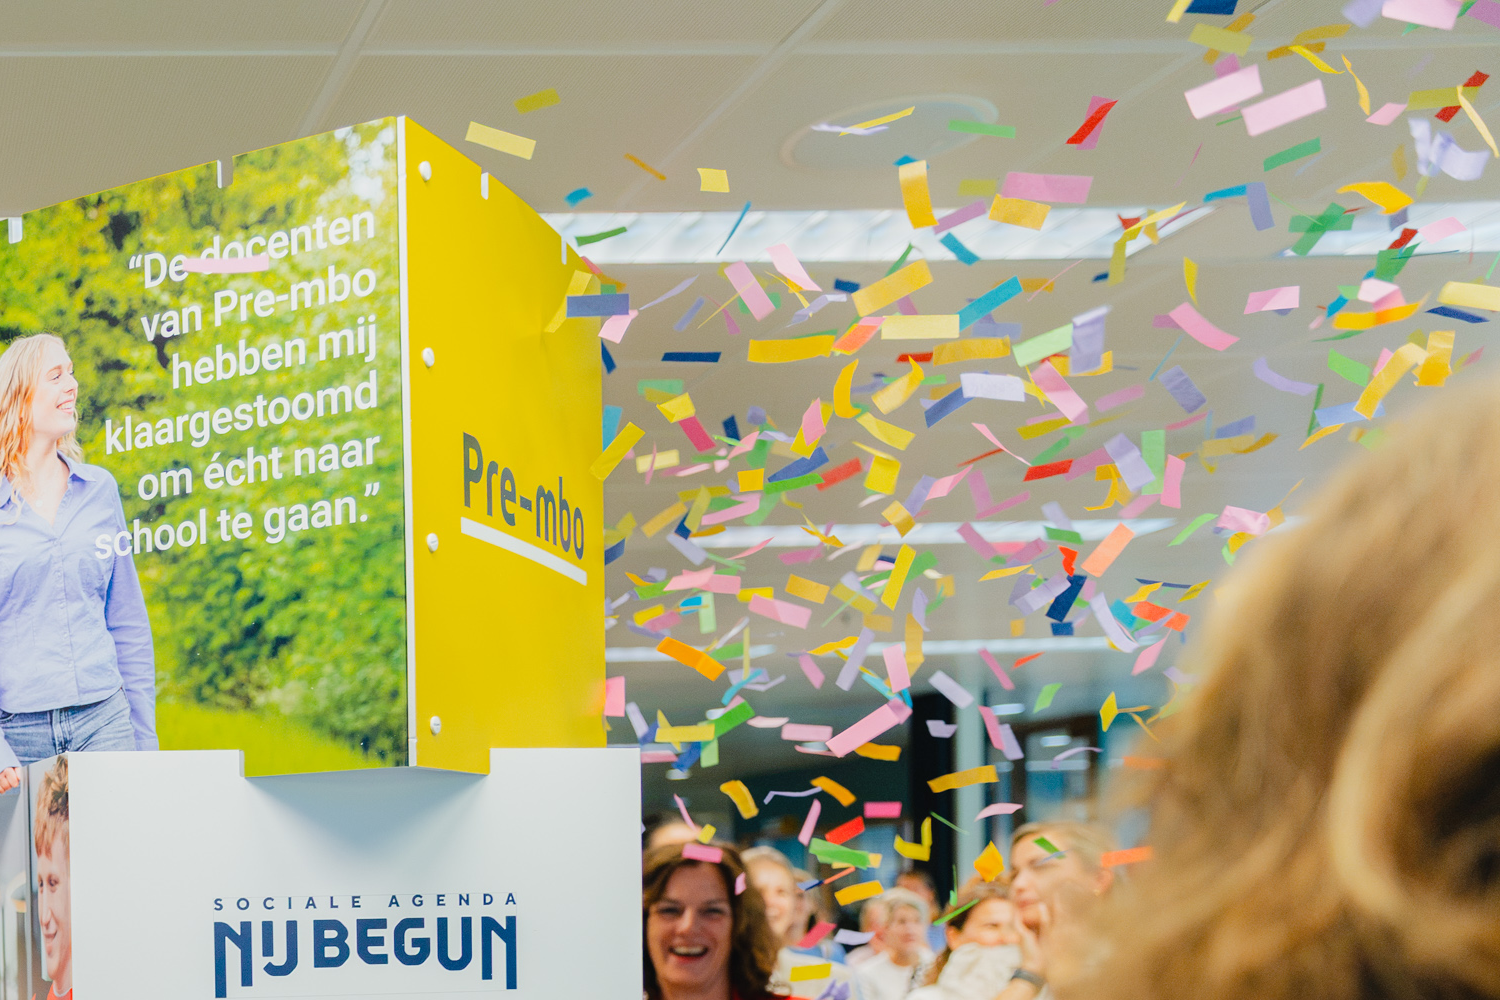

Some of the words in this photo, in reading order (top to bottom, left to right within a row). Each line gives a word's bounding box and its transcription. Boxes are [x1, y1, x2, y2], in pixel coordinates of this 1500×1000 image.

[128, 251, 188, 289] “De
[199, 211, 375, 274] docenten
[140, 303, 202, 341] van
[214, 265, 377, 327] Pre-mbo
[172, 337, 306, 389] hebben
[318, 314, 377, 362] mij
[105, 369, 378, 455] klaargestoomd
[137, 465, 193, 500] om
[203, 451, 283, 490] écht
[294, 435, 381, 476] naar
[462, 431, 585, 560] Pre-mbo
[94, 508, 207, 560] school
[216, 508, 253, 541] te
[263, 482, 380, 544] gaan.”
[213, 894, 362, 911] SOCIALE
[387, 892, 518, 909] AGENDA
